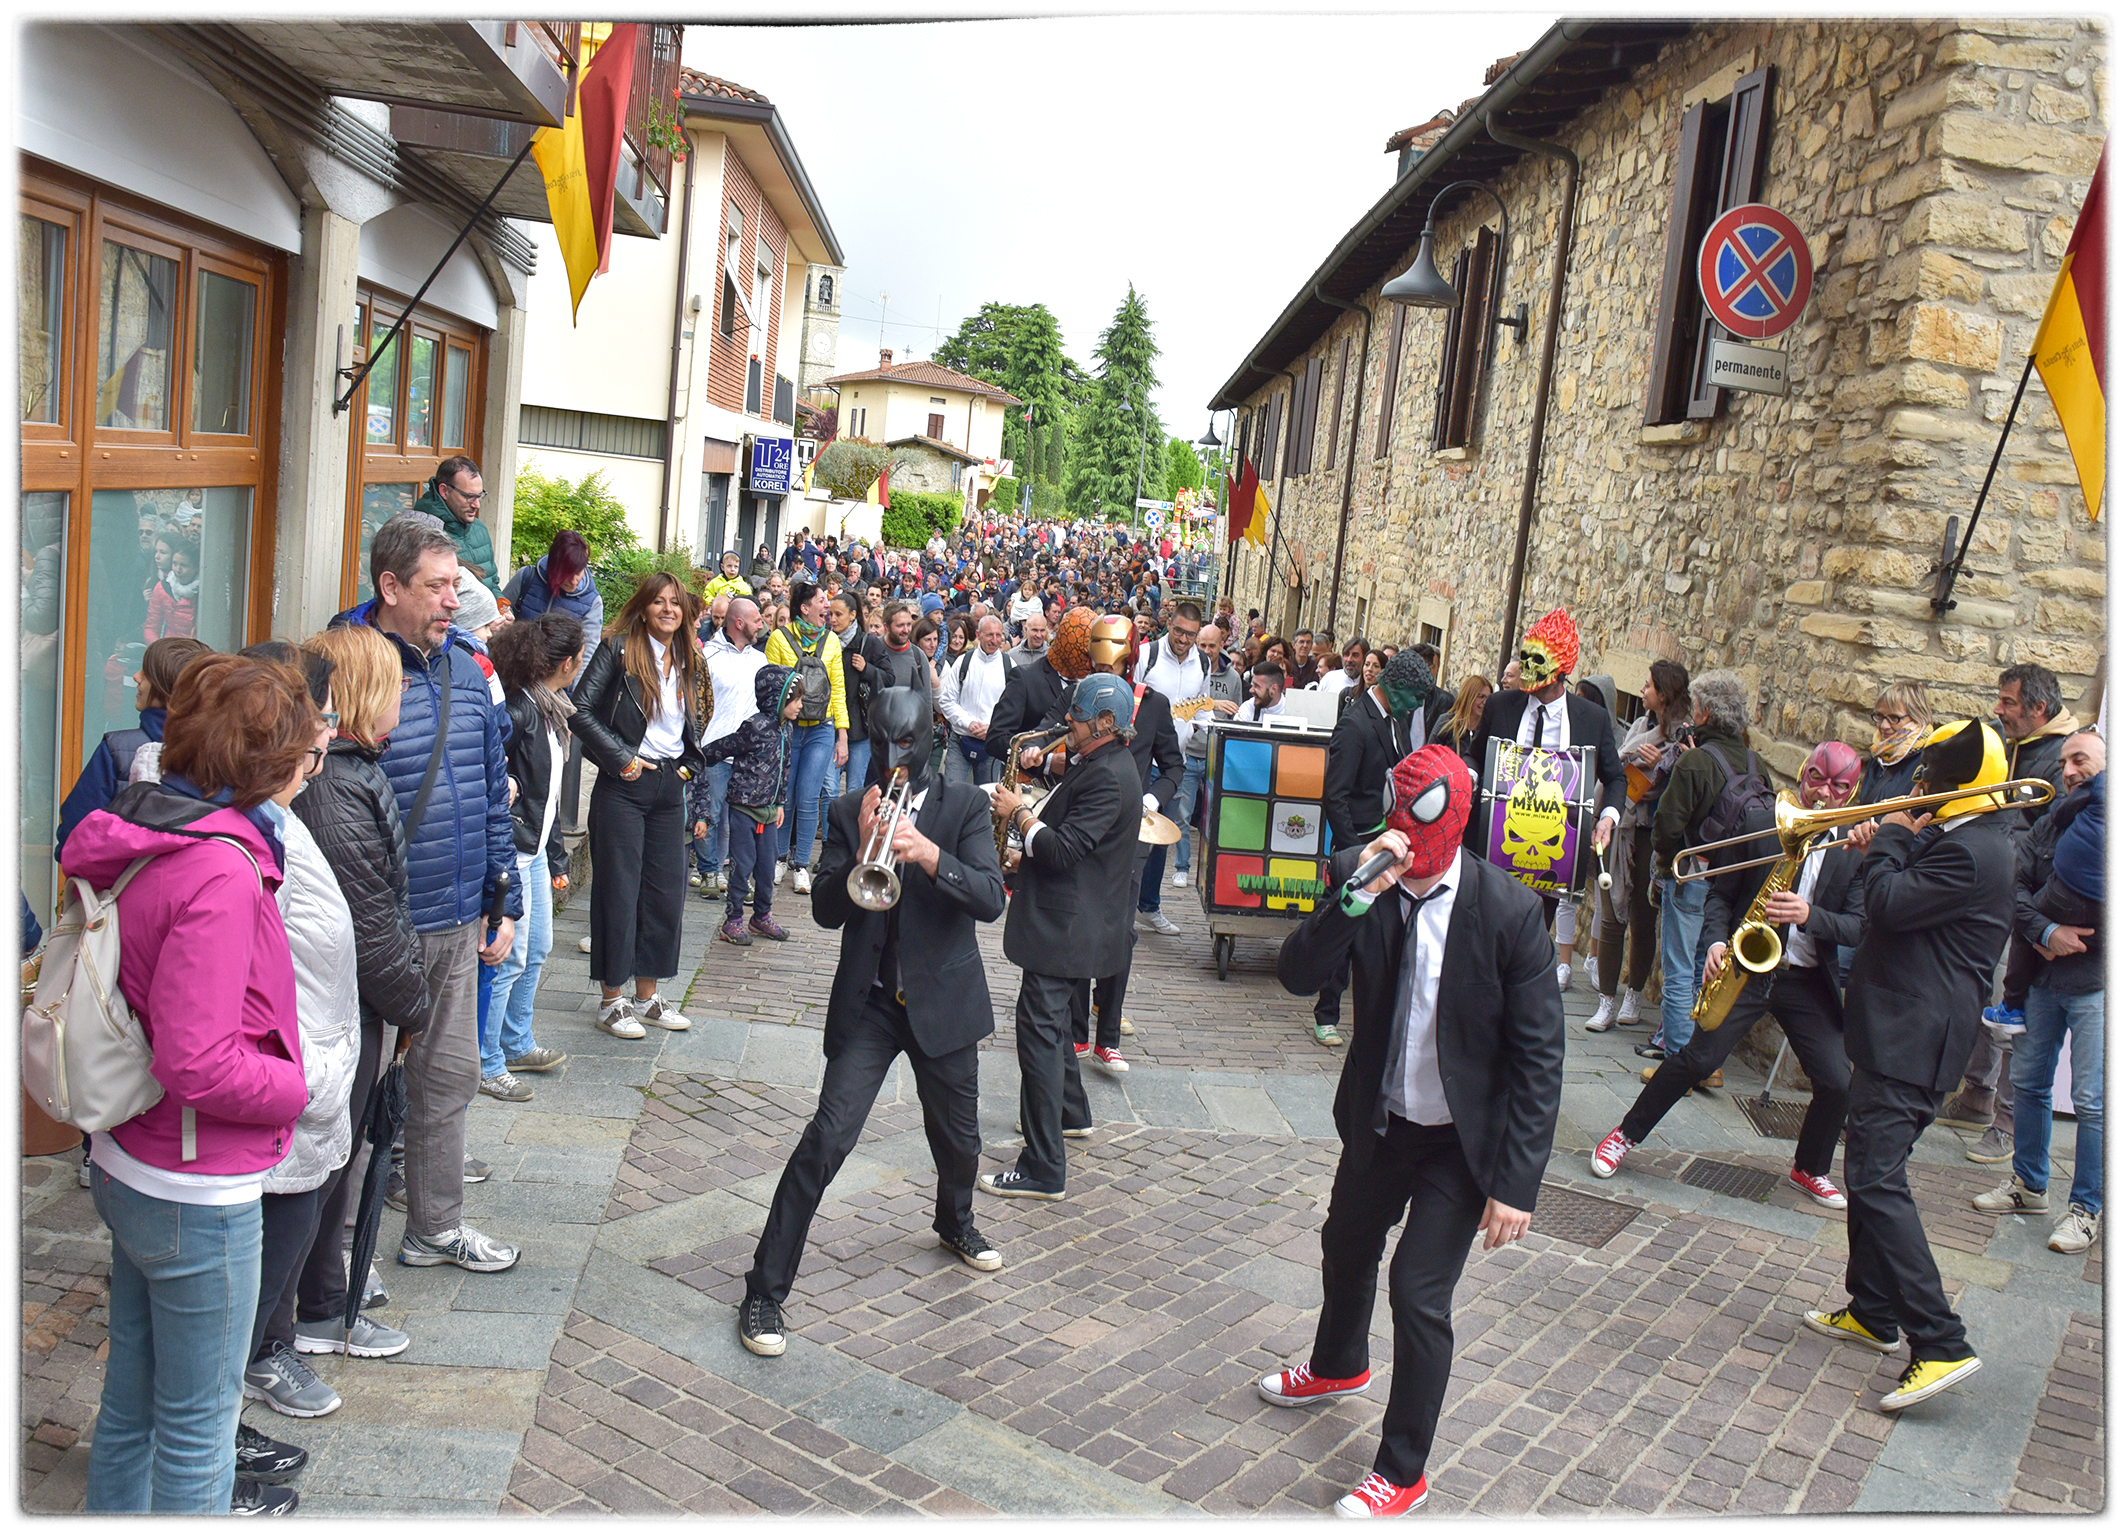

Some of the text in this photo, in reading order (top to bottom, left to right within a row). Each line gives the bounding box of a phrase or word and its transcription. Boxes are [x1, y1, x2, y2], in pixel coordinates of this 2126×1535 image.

[1714, 359, 1782, 381] permanente
[755, 436, 790, 468] T 24
[755, 467, 786, 475] DISTRIBUTORE
[774, 462, 788, 470] ORE
[755, 480, 785, 490] KOREL
